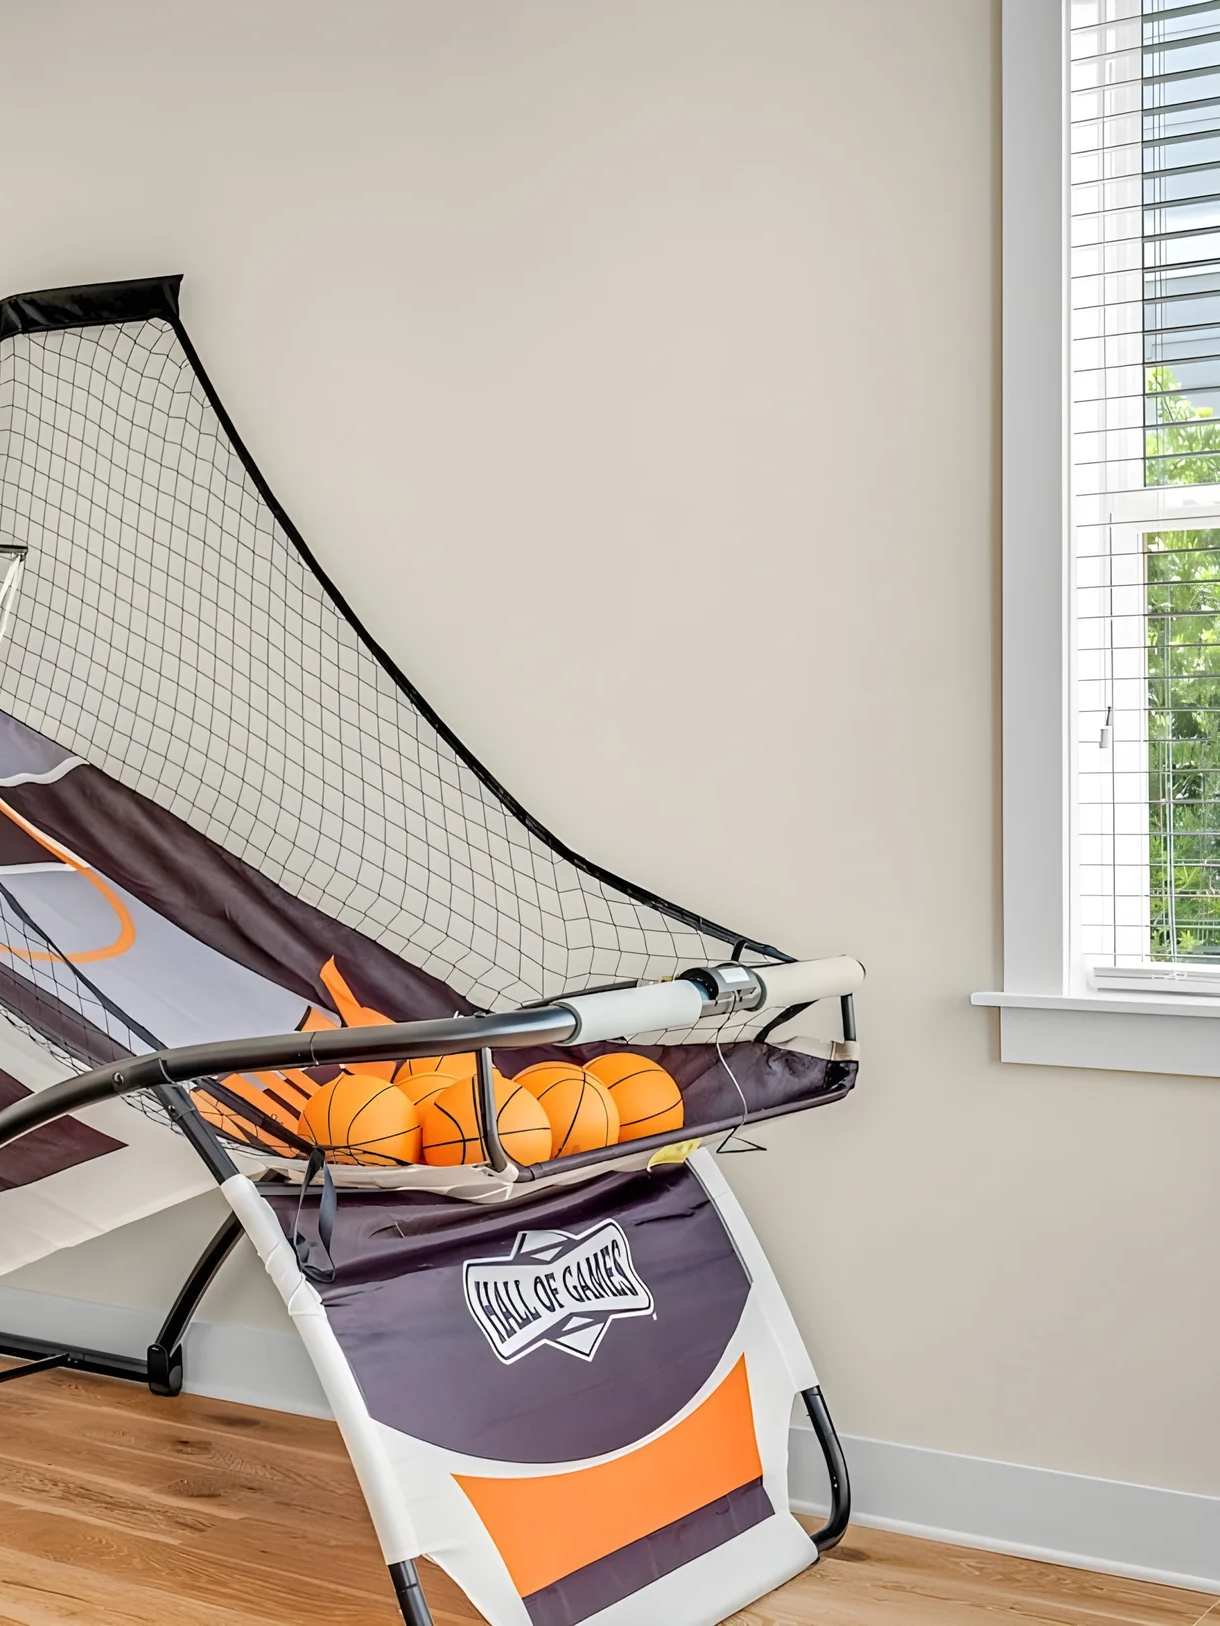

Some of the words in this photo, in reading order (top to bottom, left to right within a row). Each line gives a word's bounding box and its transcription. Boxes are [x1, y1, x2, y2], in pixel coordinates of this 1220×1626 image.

[474, 1280, 542, 1344] HALL
[533, 1272, 565, 1312] OF
[562, 1239, 639, 1302] GAMES
